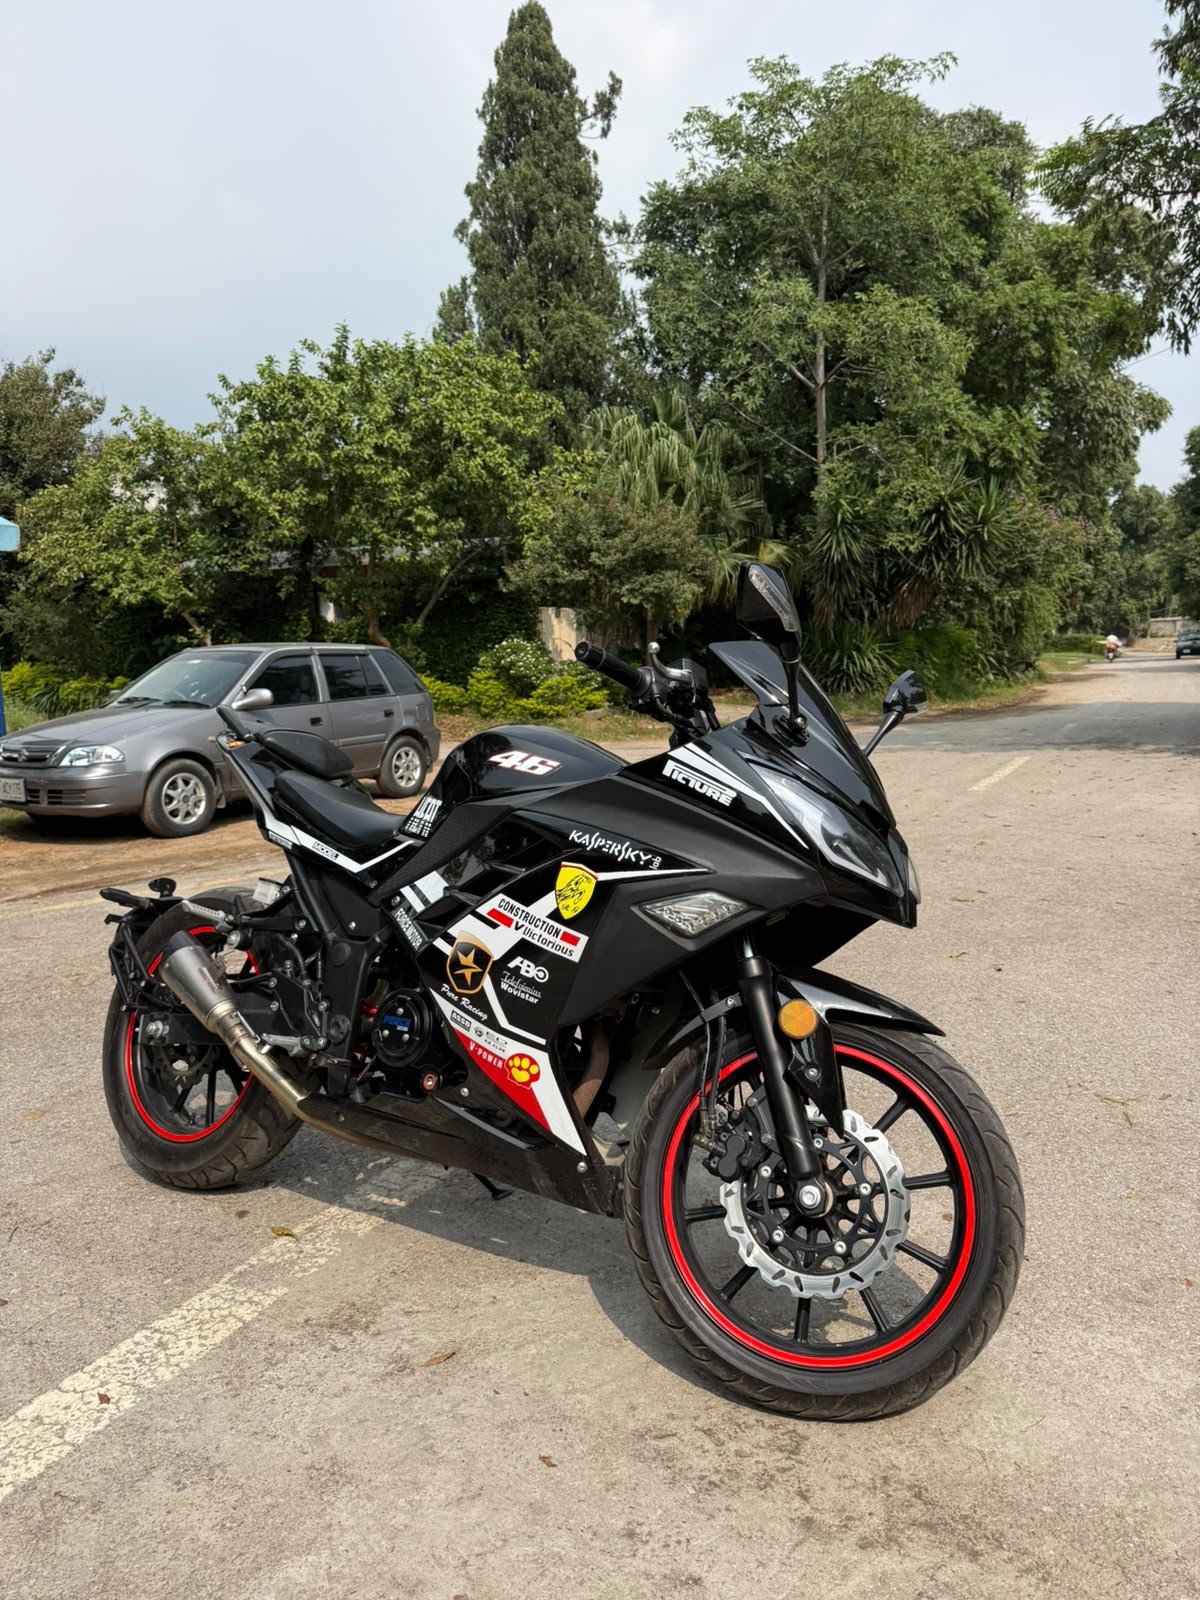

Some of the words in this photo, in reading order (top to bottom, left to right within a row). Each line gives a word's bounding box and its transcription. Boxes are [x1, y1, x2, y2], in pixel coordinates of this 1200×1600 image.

[487, 750, 561, 776] 46
[662, 759, 737, 806] PICTURE
[569, 830, 652, 865] KASPERSKY
[394, 907, 411, 932] FORCE
[405, 924, 422, 951] MOTOR
[498, 898, 561, 939] CONSTRUCTION
[441, 983, 459, 1001] Pure
[460, 997, 488, 1021] Racing
